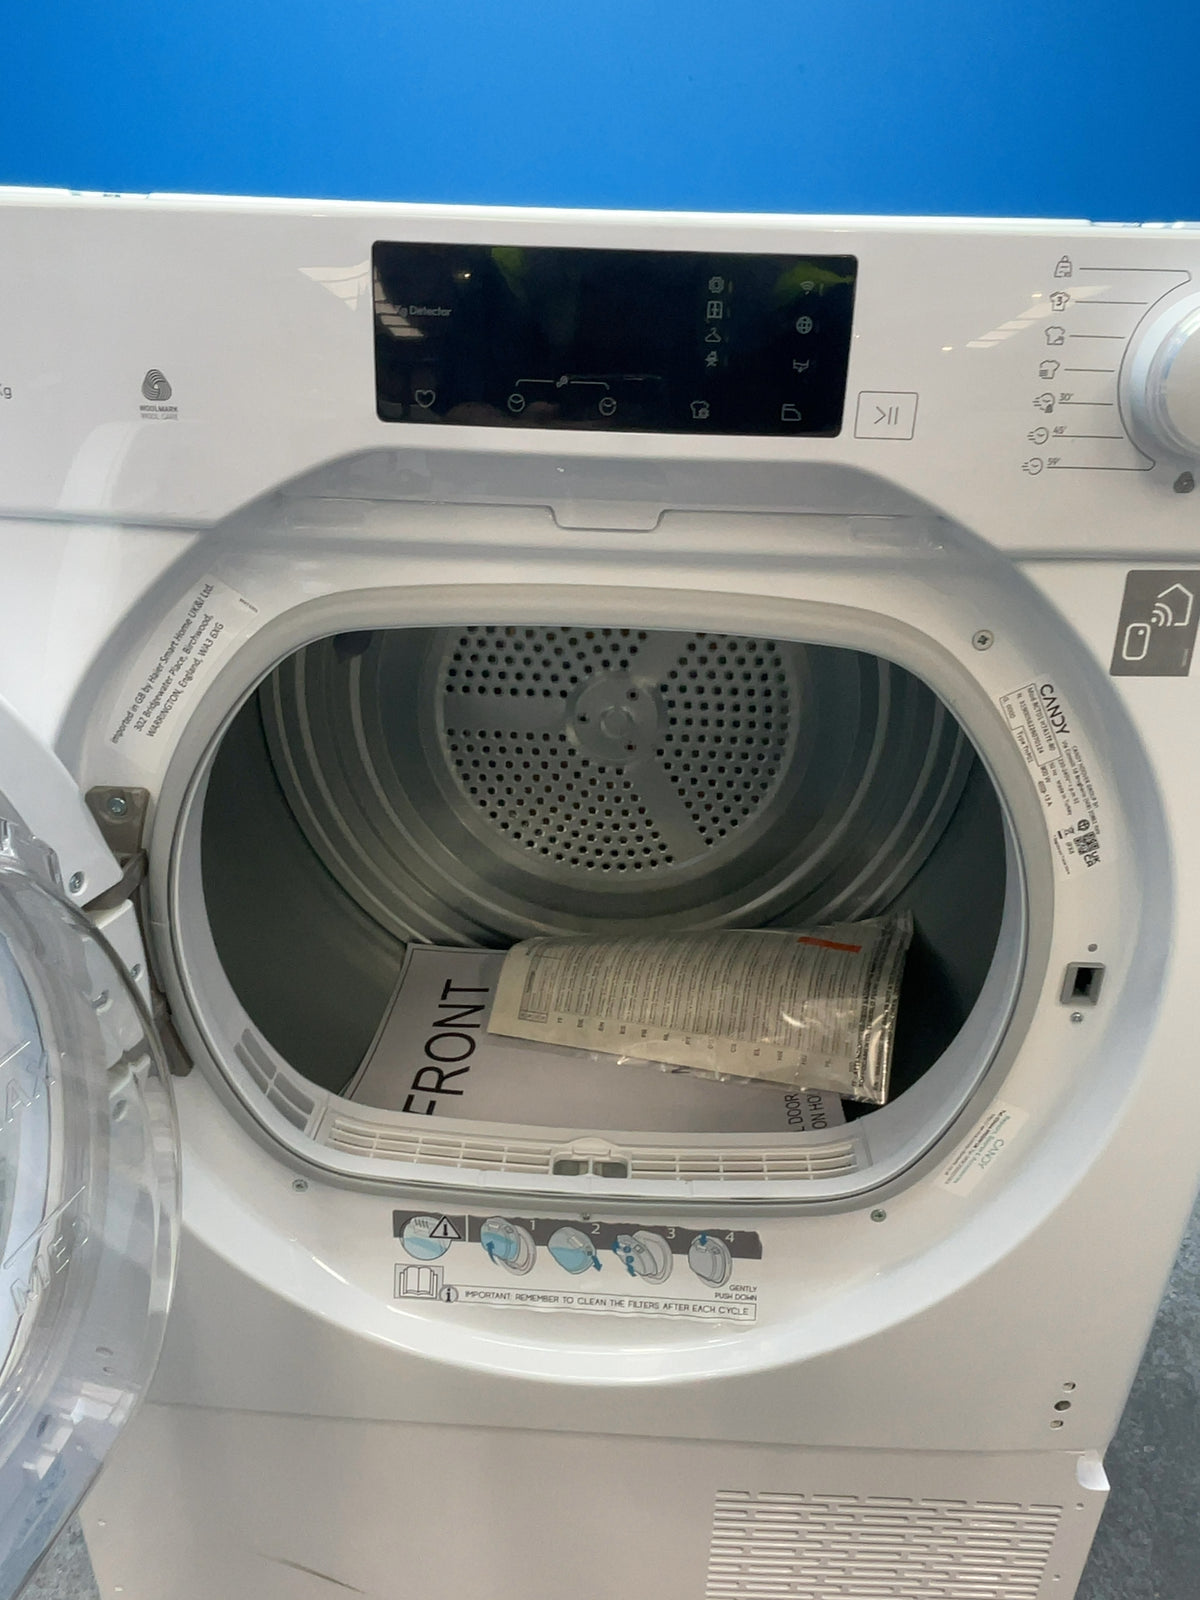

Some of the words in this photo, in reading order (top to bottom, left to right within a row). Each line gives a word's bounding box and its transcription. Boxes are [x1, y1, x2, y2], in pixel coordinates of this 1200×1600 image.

[409, 304, 452, 316] Detector
[139, 404, 179, 412] WOOLMARK
[173, 618, 192, 641] Home
[159, 640, 178, 663] Smart
[178, 657, 203, 687] England,
[197, 638, 213, 656] WA3
[133, 716, 147, 731] 302
[142, 675, 172, 717] Bridgewater
[182, 613, 213, 654] Birchwood,
[147, 662, 163, 683] Haier
[140, 682, 153, 693] by
[134, 691, 145, 704] GB
[131, 704, 138, 712] in
[1040, 683, 1069, 733] CANDY
[402, 978, 490, 1115] FRONT
[784, 1093, 804, 1126] DOOR
[978, 1138, 1004, 1169] CANDY
[591, 1223, 601, 1235] 2
[666, 1227, 676, 1240] 3
[725, 1231, 735, 1243] 4
[714, 1291, 733, 1300] PUSH
[734, 1293, 758, 1301] DOWN
[729, 1284, 758, 1293] GENTLY
[515, 1293, 560, 1304] REMEMBER
[562, 1296, 574, 1304] TO
[577, 1297, 607, 1307] CLEAN
[610, 1299, 625, 1308] THE
[627, 1300, 660, 1310] FILTERS
[662, 1303, 690, 1312] AFTER
[692, 1304, 716, 1314] EACH
[718, 1306, 749, 1316] CYCLE
